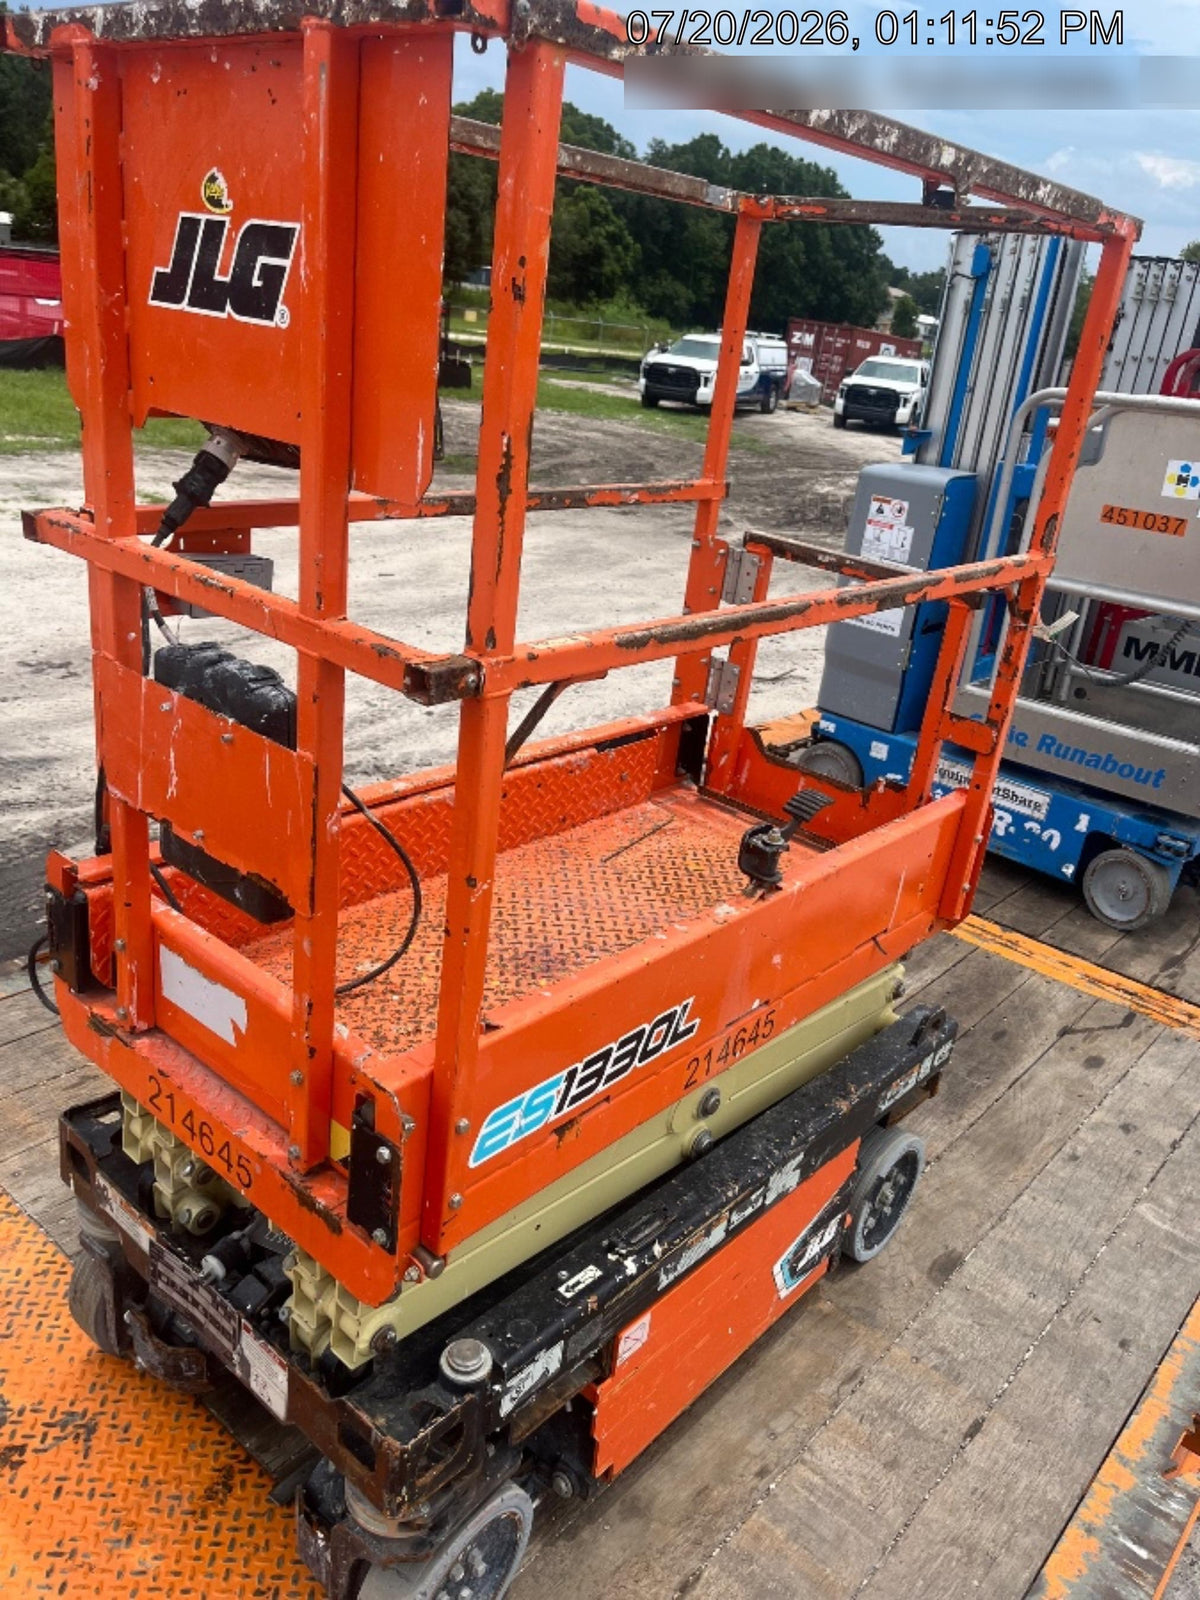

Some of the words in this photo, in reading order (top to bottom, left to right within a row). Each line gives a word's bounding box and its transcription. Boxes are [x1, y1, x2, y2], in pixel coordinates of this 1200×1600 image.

[791, 331, 816, 347] ZM
[1101, 506, 1186, 535] 451037
[1123, 636, 1200, 677] MM
[1035, 732, 1168, 790] Runabout
[683, 1009, 777, 1091] 214645
[469, 996, 701, 1168] ES1330L
[148, 1074, 253, 1189] 214645
